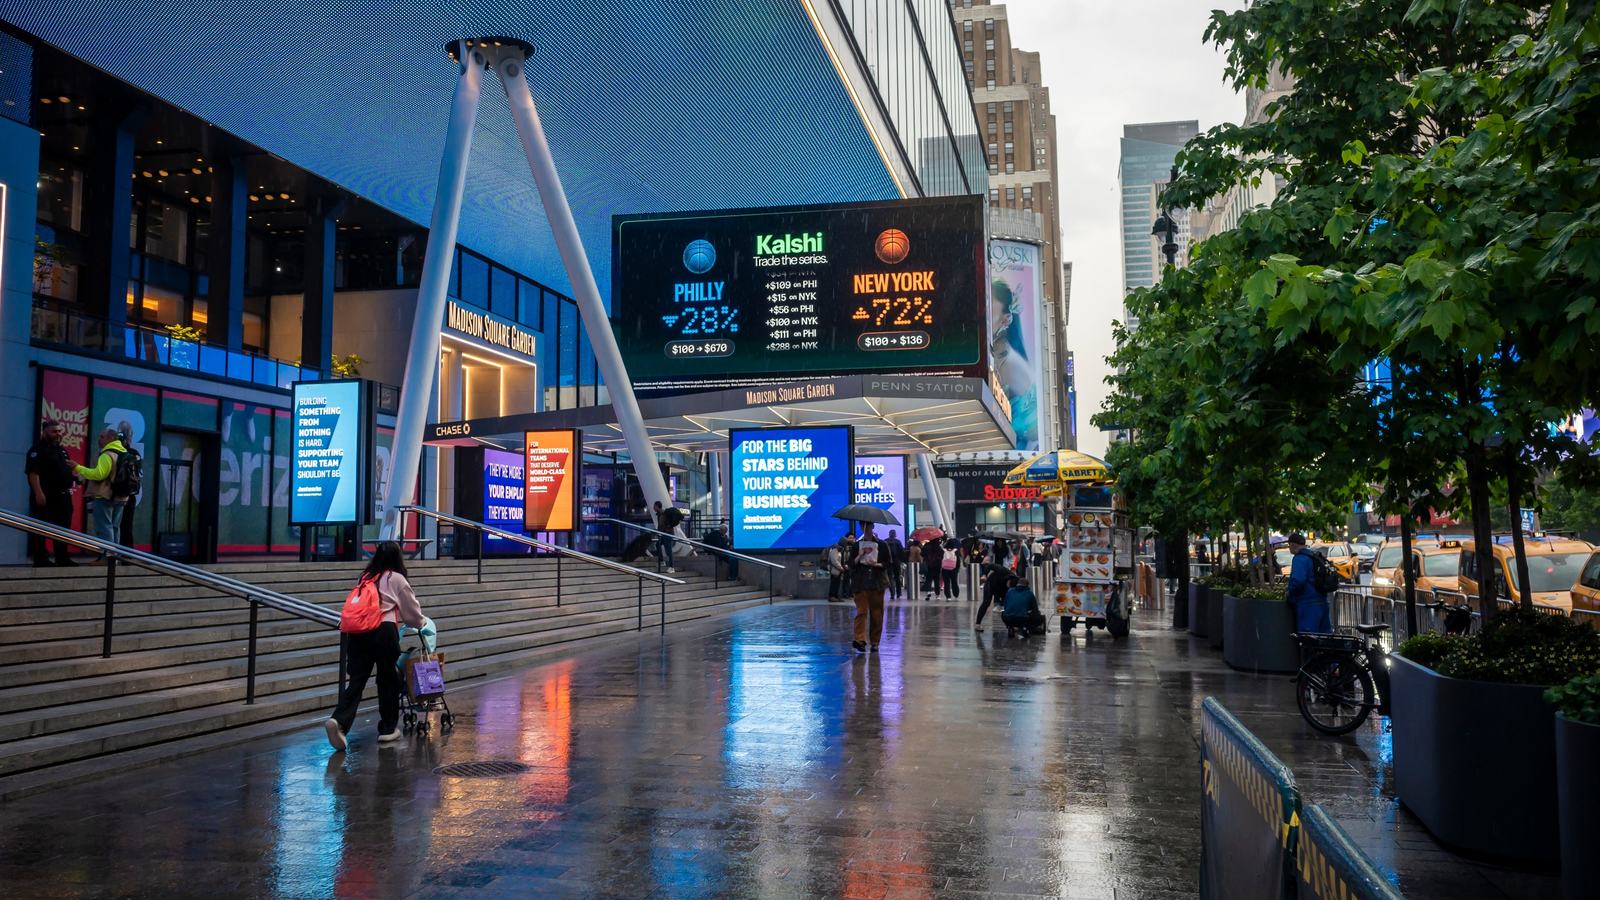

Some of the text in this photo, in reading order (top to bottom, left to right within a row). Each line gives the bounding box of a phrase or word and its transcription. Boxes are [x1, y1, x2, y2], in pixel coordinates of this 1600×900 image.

[756, 232, 823, 255] Kalshi
[753, 254, 829, 267] Trade the series.
[991, 246, 1033, 264] OVSKI
[765, 281, 791, 291] +$109
[802, 280, 817, 289] PHI
[854, 271, 935, 294] NEW YORK
[674, 281, 725, 302] PHILLY
[767, 293, 787, 303] +$15
[798, 292, 817, 301] NYK
[769, 305, 790, 315] +$56
[800, 304, 814, 313] PHI
[872, 296, 932, 326] 72%
[681, 306, 739, 334] 28%
[765, 317, 791, 327] +$100
[801, 317, 819, 325] NYK
[448, 300, 536, 357] MADISON SQUARE GARDEN
[802, 329, 817, 338] PHI
[865, 335, 923, 348] $100 $136
[672, 343, 728, 355] $100 $670
[872, 381, 975, 393] PENN STATION
[746, 383, 835, 405] MADISON SQUARE GARDEN
[299, 397, 327, 405] BUILDING
[299, 407, 341, 416] SOMETHING
[299, 418, 320, 427] FROM
[299, 428, 331, 437] NOTHING
[436, 425, 463, 437] CHASE
[299, 439, 305, 447] IS
[742, 438, 813, 454] FOR THE BIG
[298, 449, 344, 458] SUPPORTING
[298, 459, 339, 469] YOUR TEAM
[742, 456, 829, 471] STARS BEHIND
[864, 464, 884, 475] FOR
[298, 469, 330, 479] SHOULDN'T
[972, 470, 982, 478] OF
[1063, 468, 1097, 478] SABRET
[742, 475, 819, 490] YOUR SMALL
[489, 484, 505, 499] YOUR
[743, 495, 812, 509] BUSINESS.
